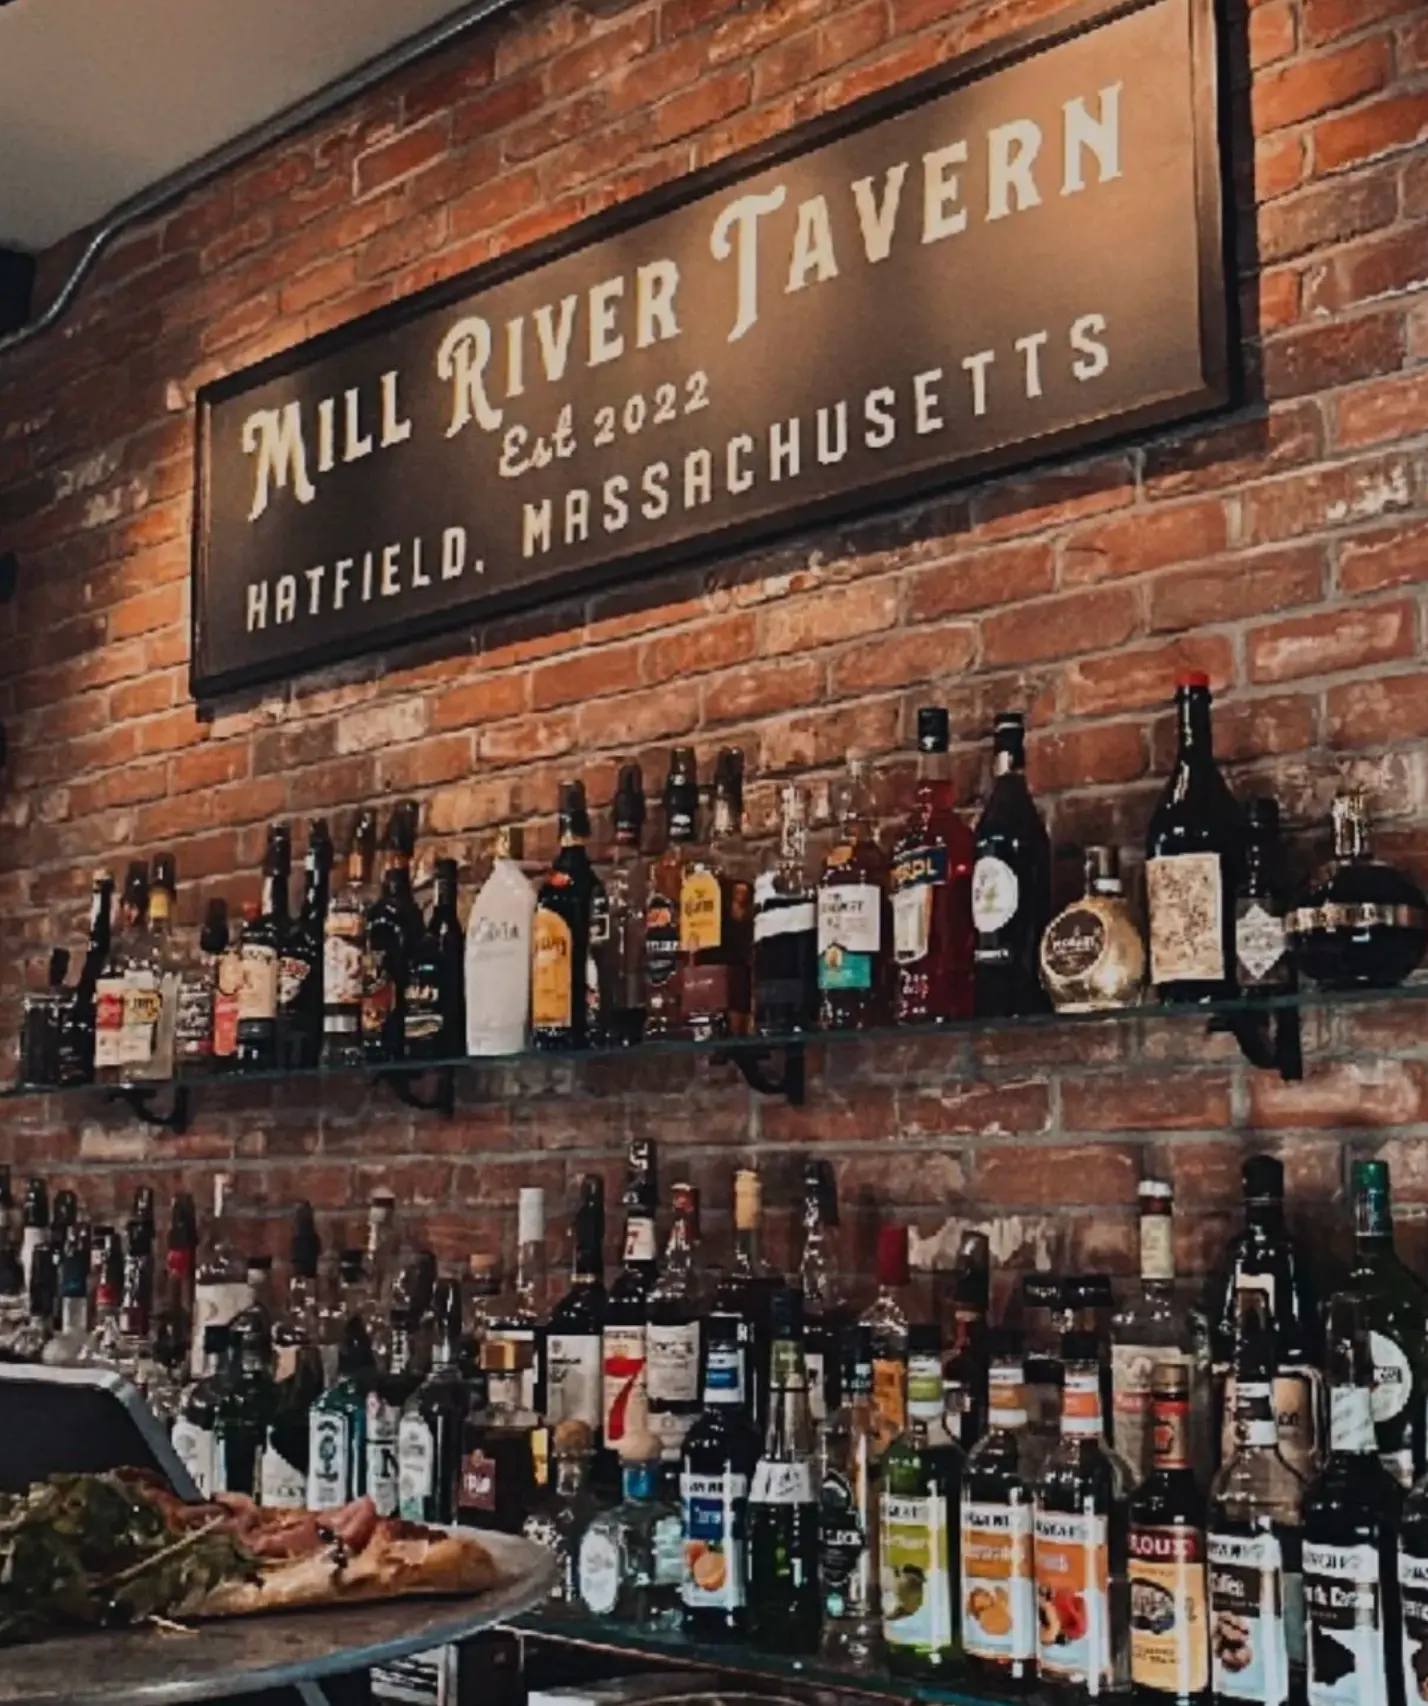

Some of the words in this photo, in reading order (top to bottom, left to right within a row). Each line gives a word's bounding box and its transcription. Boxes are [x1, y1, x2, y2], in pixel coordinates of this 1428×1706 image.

[241, 370, 412, 522] MILL
[436, 259, 681, 439] RIVER
[710, 81, 1121, 342] TAVERN
[499, 403, 577, 478] Est
[593, 370, 710, 448] 2022
[522, 313, 1109, 558] MASSACHUSETTS
[604, 1353, 647, 1441] 7
